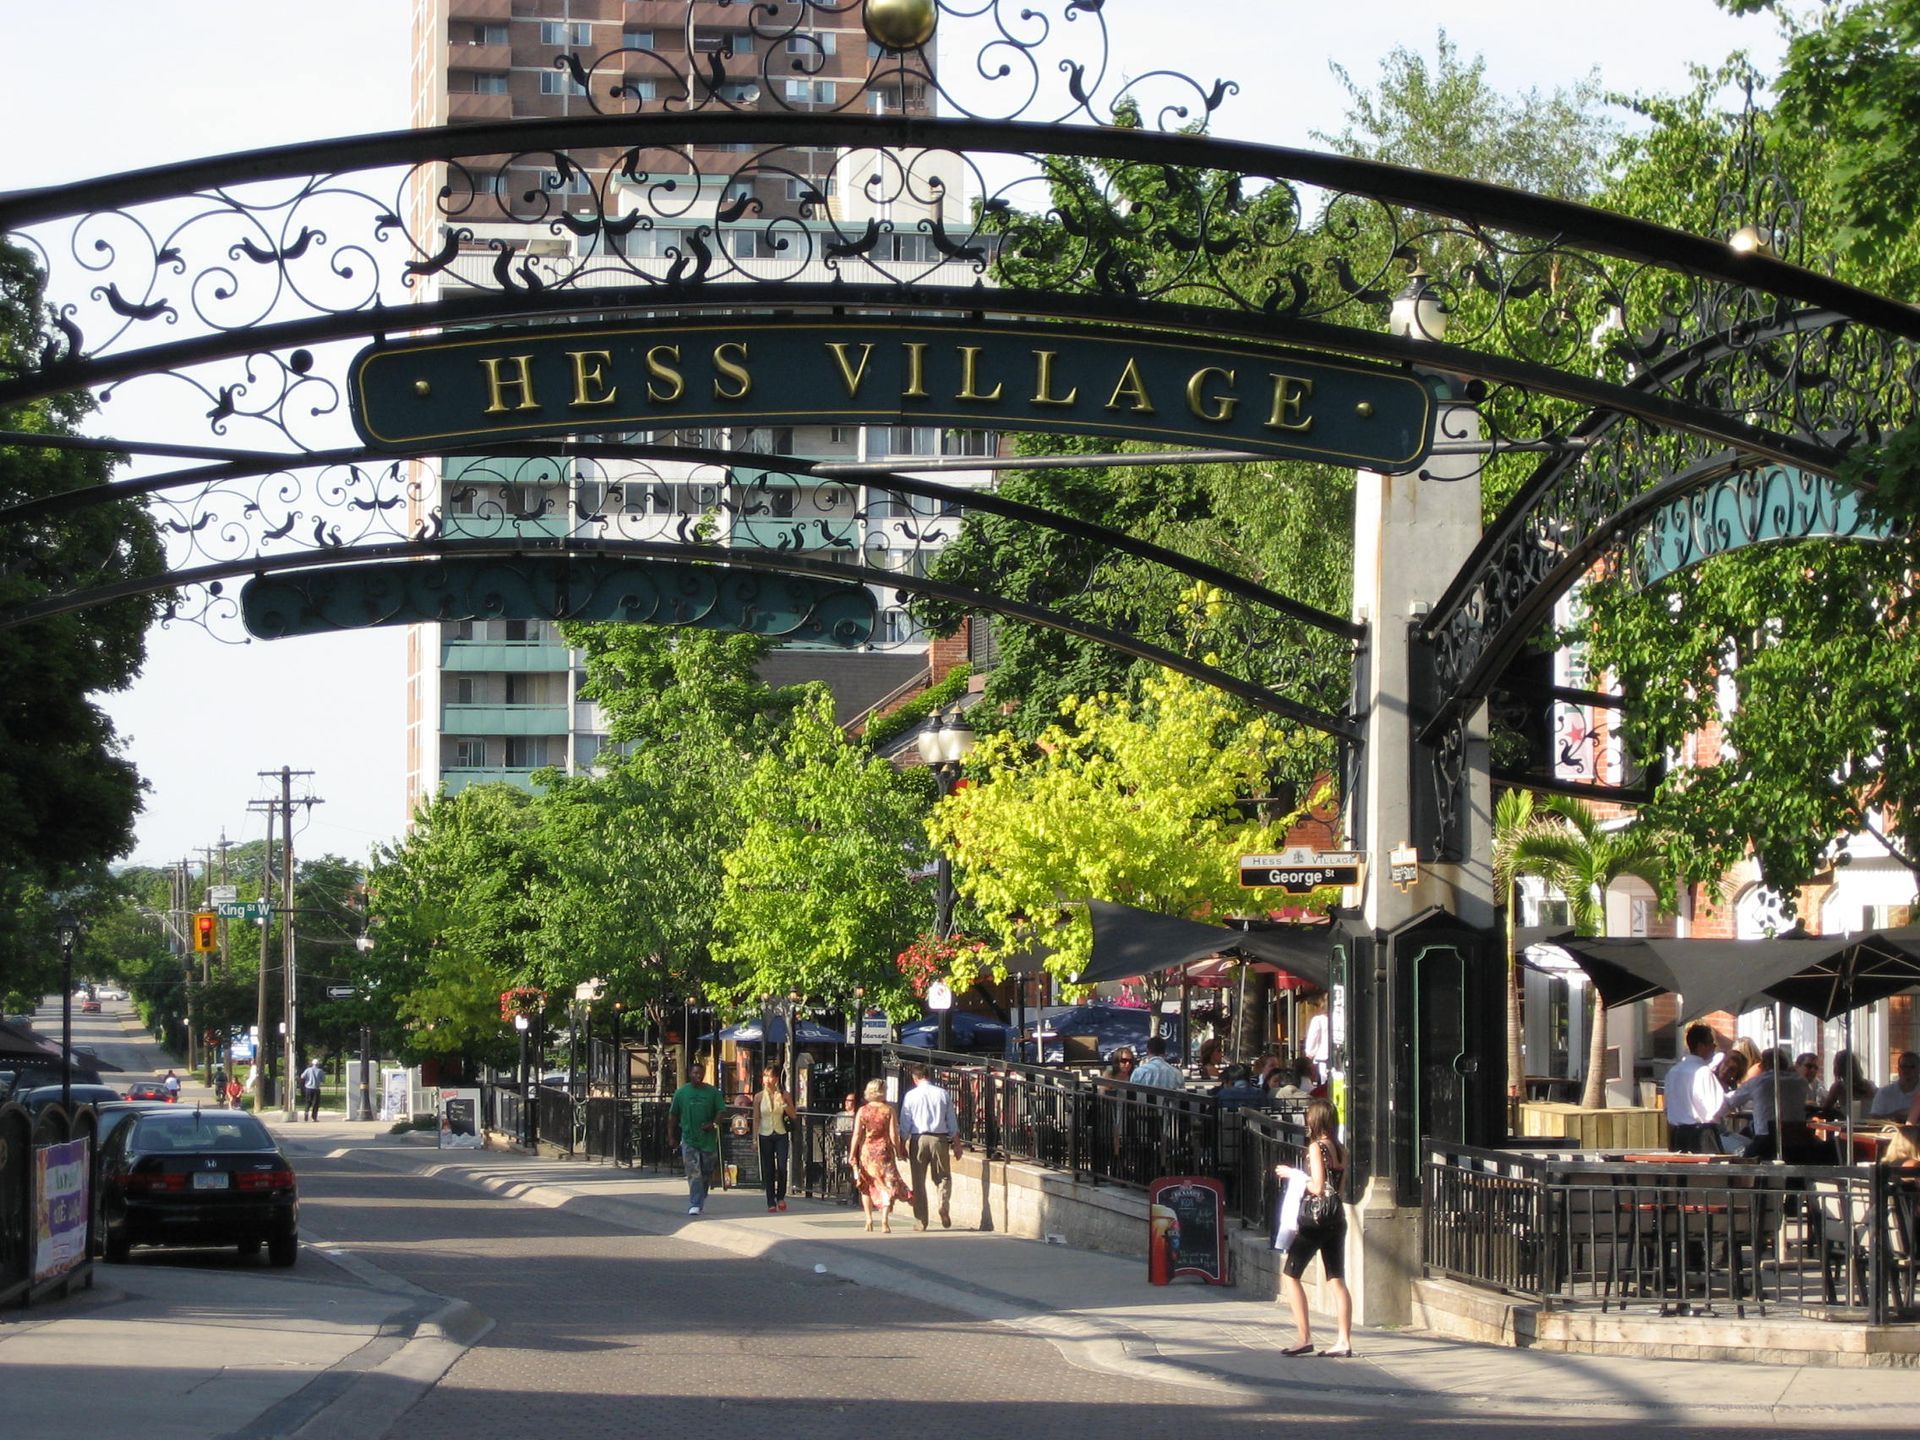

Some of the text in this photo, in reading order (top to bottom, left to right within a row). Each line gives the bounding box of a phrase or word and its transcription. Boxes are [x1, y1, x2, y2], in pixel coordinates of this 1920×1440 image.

[479, 342, 1314, 432] HESS VILLAGE
[1252, 855, 1356, 865] HESS VILLAGE
[1269, 869, 1335, 886] George St
[218, 903, 270, 918] King St W
